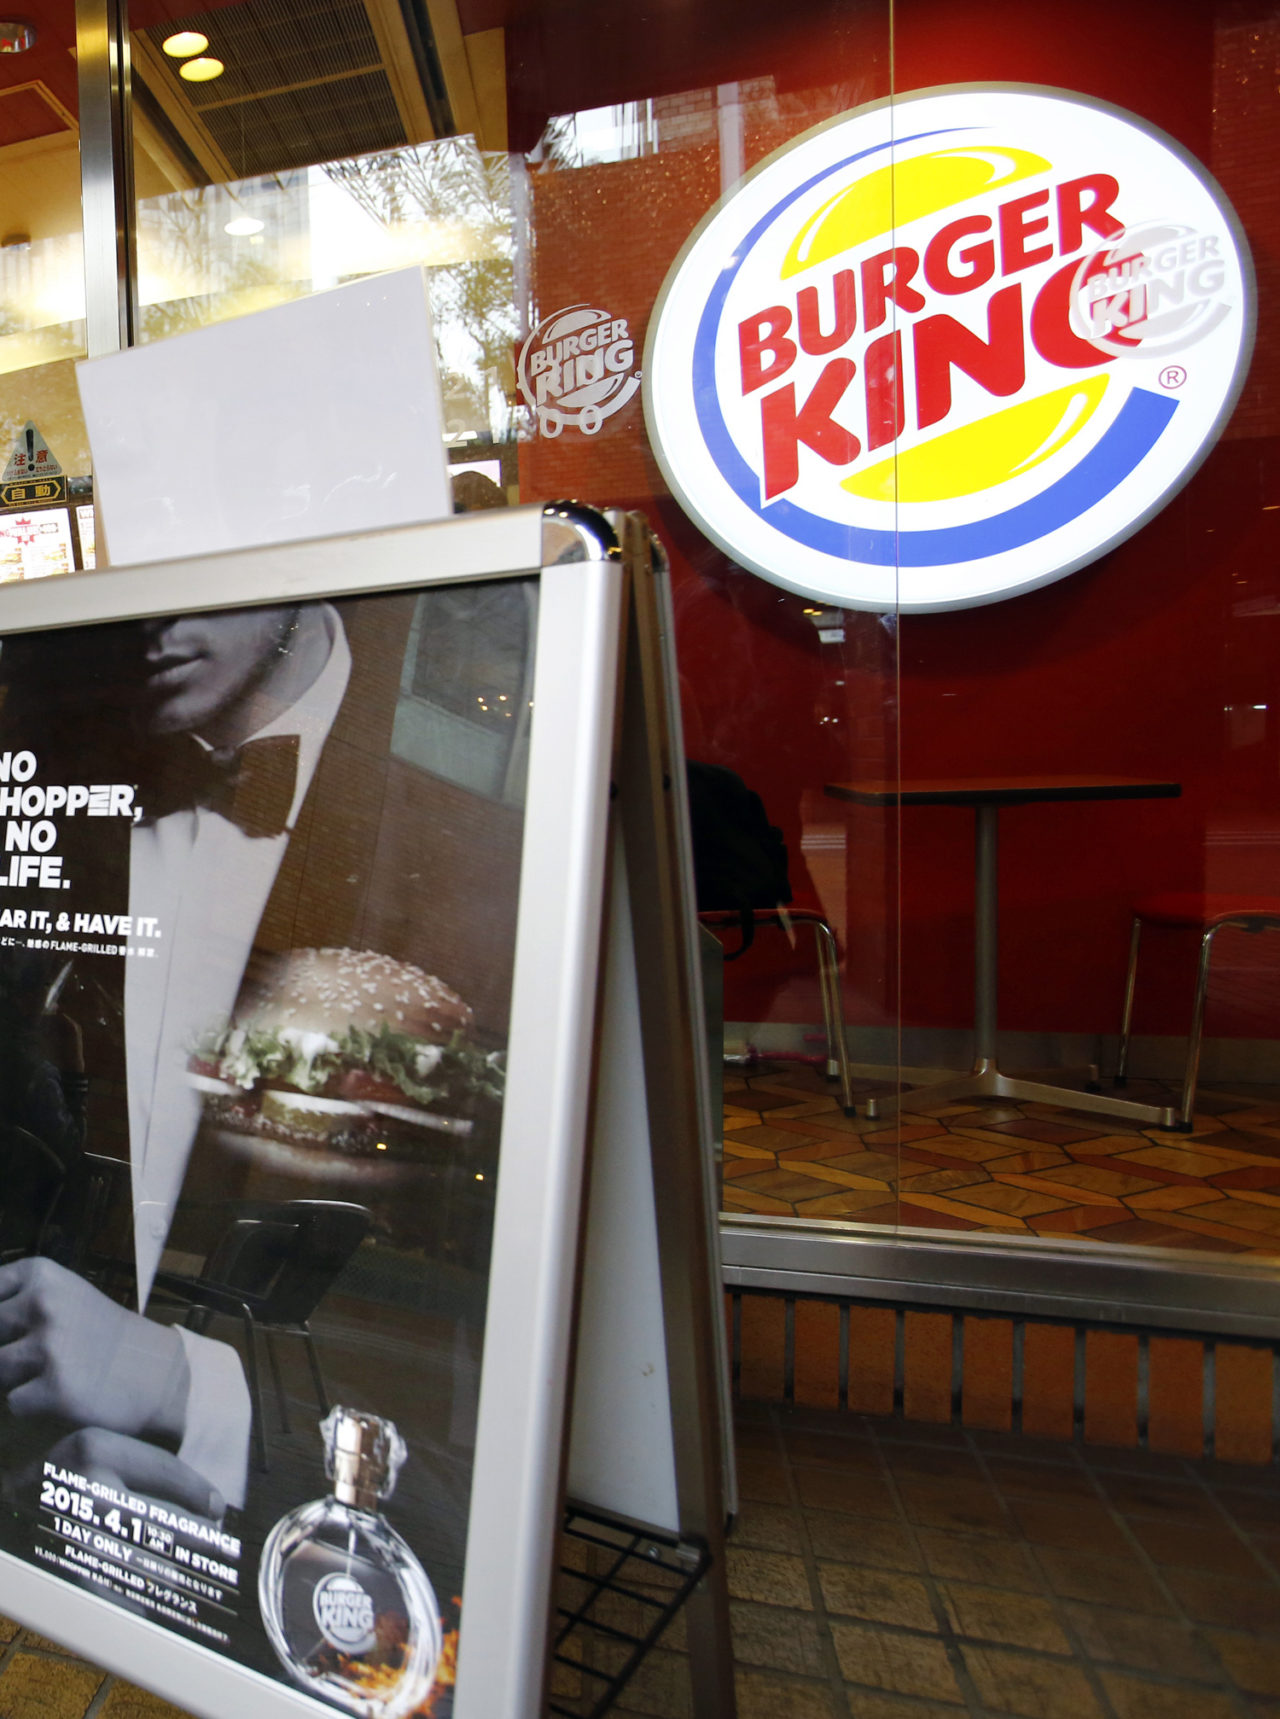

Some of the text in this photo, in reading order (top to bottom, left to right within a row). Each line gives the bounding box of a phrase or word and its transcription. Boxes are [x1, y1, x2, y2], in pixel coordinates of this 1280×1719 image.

[737, 172, 1126, 398] BURGER
[1087, 235, 1220, 303] BURGER
[1092, 259, 1225, 339] KING
[530, 318, 629, 377] BURGER
[535, 339, 634, 406] KING
[760, 248, 1151, 502] KING
[4, 820, 57, 853] NO
[30, 911, 52, 934] IT,
[56, 912, 70, 932] &
[74, 913, 132, 936] HAVE
[136, 917, 162, 938] IT.
[50, 940, 117, 955] FLAME-GRILLED
[43, 1461, 241, 1557] FLAME-GRILLED FRAGRANCE
[54, 1516, 133, 1562] 1 DAY ONLY
[148, 1538, 165, 1550] AM
[175, 1545, 239, 1585] IN STORE
[65, 1544, 145, 1590] FLAME-GRILLED
[146, 1579, 198, 1615] フレグランス
[320, 1591, 373, 1608] BURGER
[320, 1606, 375, 1630] KING
